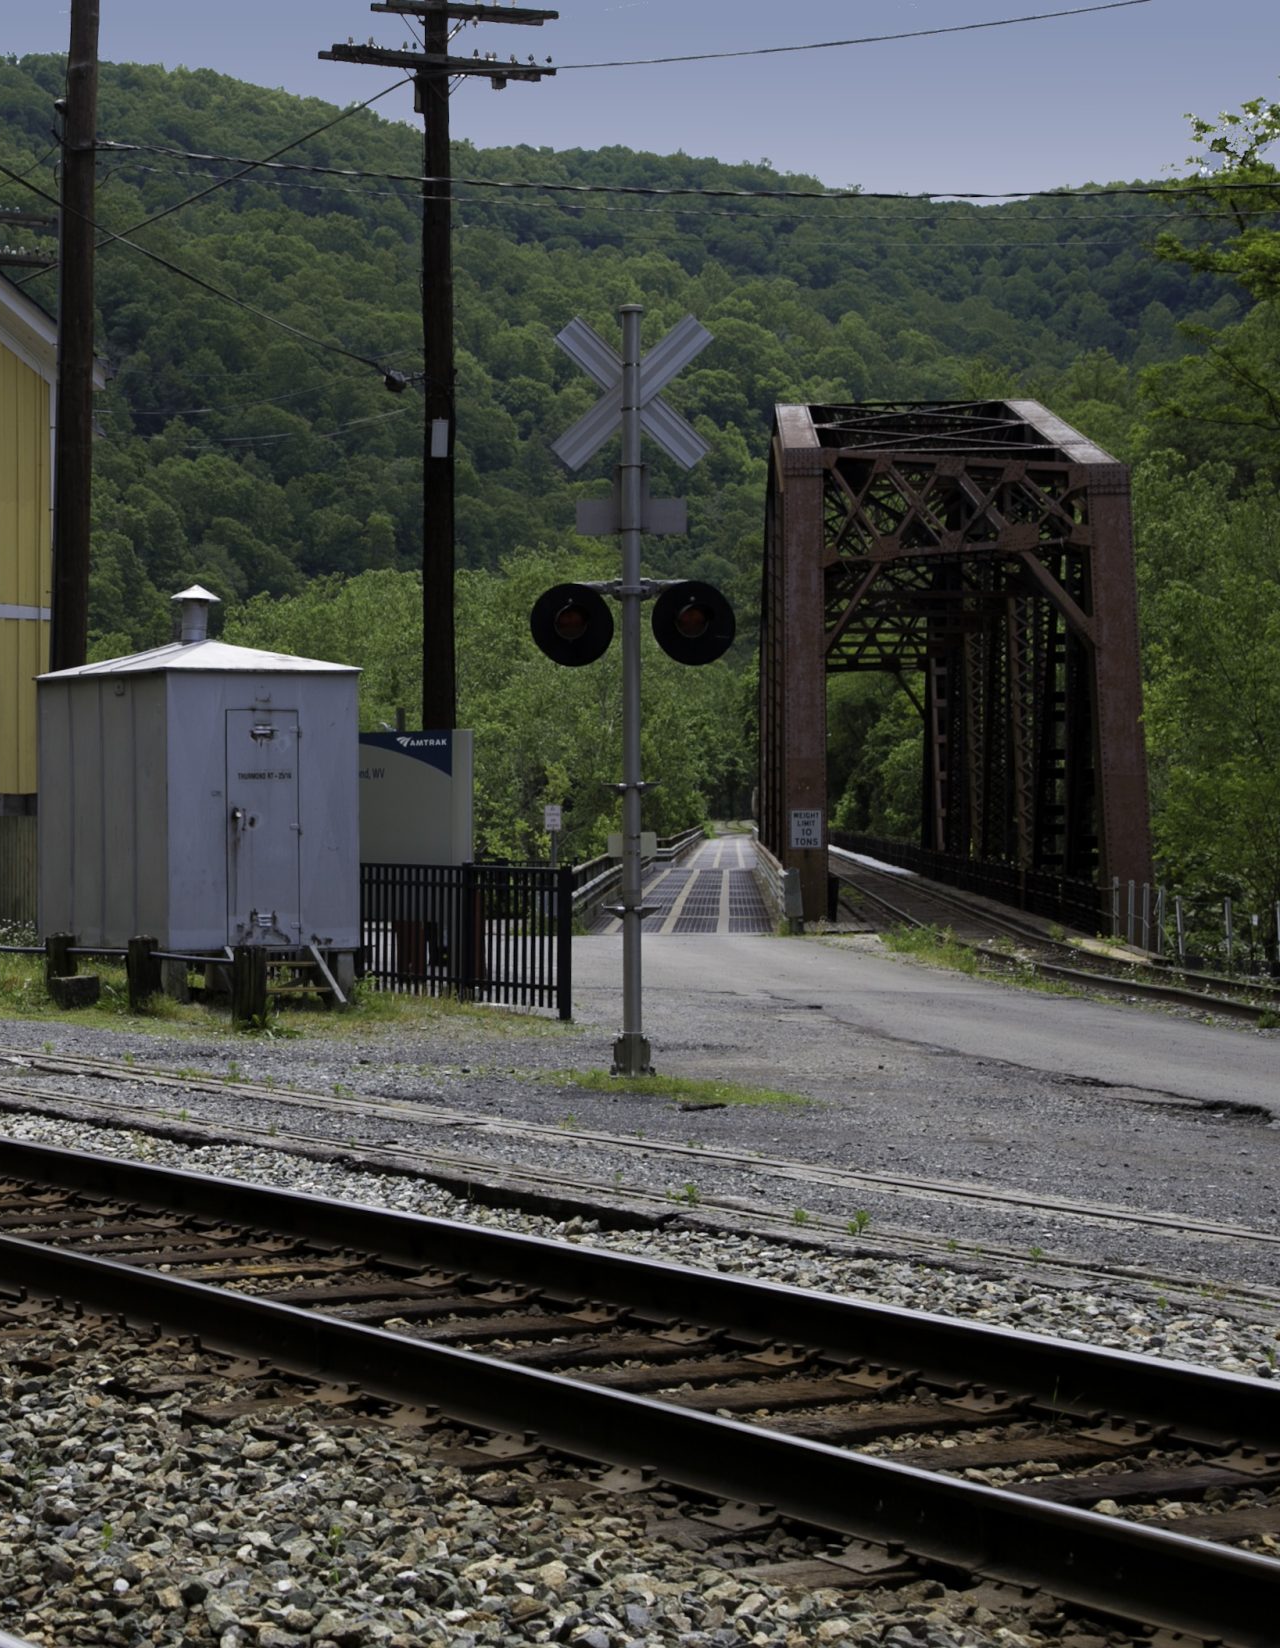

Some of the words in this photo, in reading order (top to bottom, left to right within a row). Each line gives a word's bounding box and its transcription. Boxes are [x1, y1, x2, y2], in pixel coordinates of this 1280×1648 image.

[410, 738, 447, 747] AMTRAK
[801, 828, 812, 836] 10
[795, 837, 818, 846] TONS
